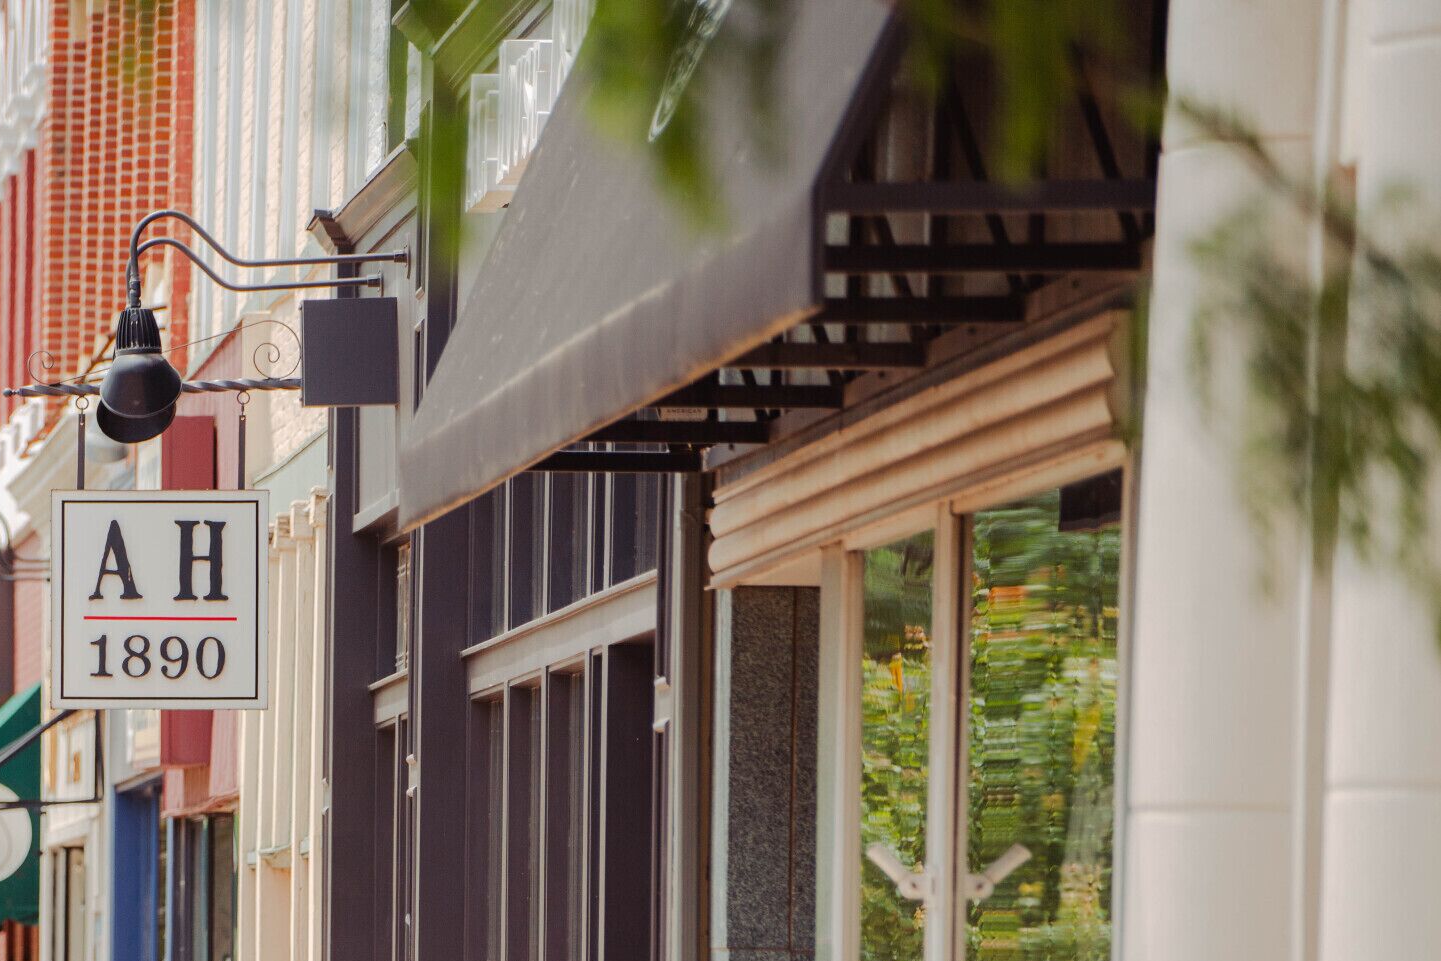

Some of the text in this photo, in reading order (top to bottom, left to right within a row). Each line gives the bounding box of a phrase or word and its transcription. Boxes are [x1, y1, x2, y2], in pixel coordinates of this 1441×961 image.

[88, 519, 229, 602] A H
[89, 634, 227, 680] 1890
